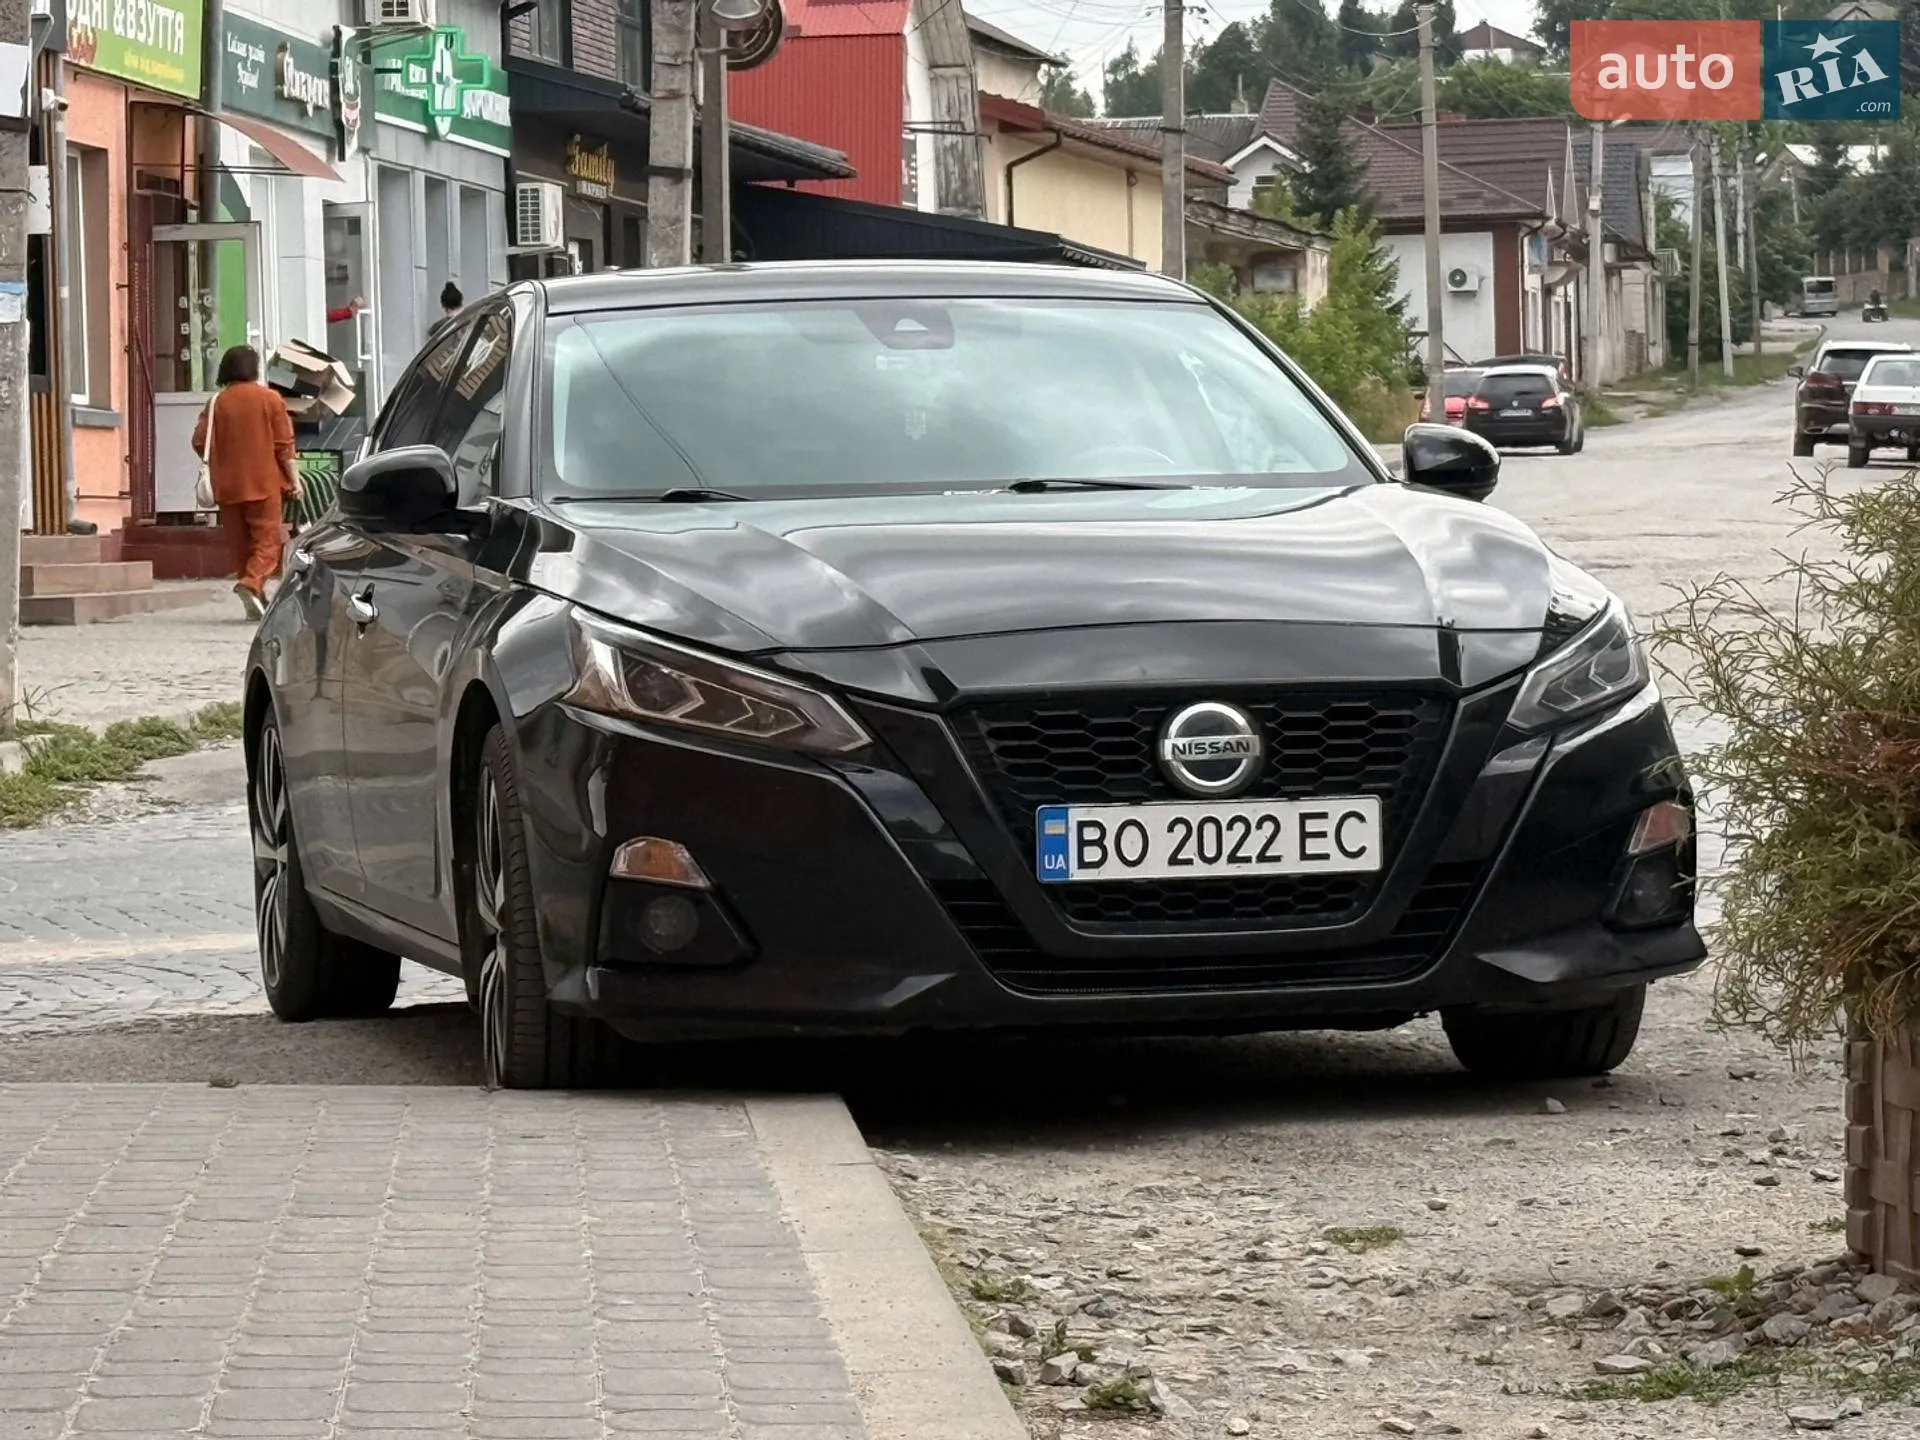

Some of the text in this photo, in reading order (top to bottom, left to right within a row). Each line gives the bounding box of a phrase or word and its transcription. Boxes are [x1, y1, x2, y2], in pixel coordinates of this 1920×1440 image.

[1171, 740, 1250, 756] NISSAN
[1076, 810, 1368, 870] BO 2022 EC
[1044, 855, 1067, 870] UA
